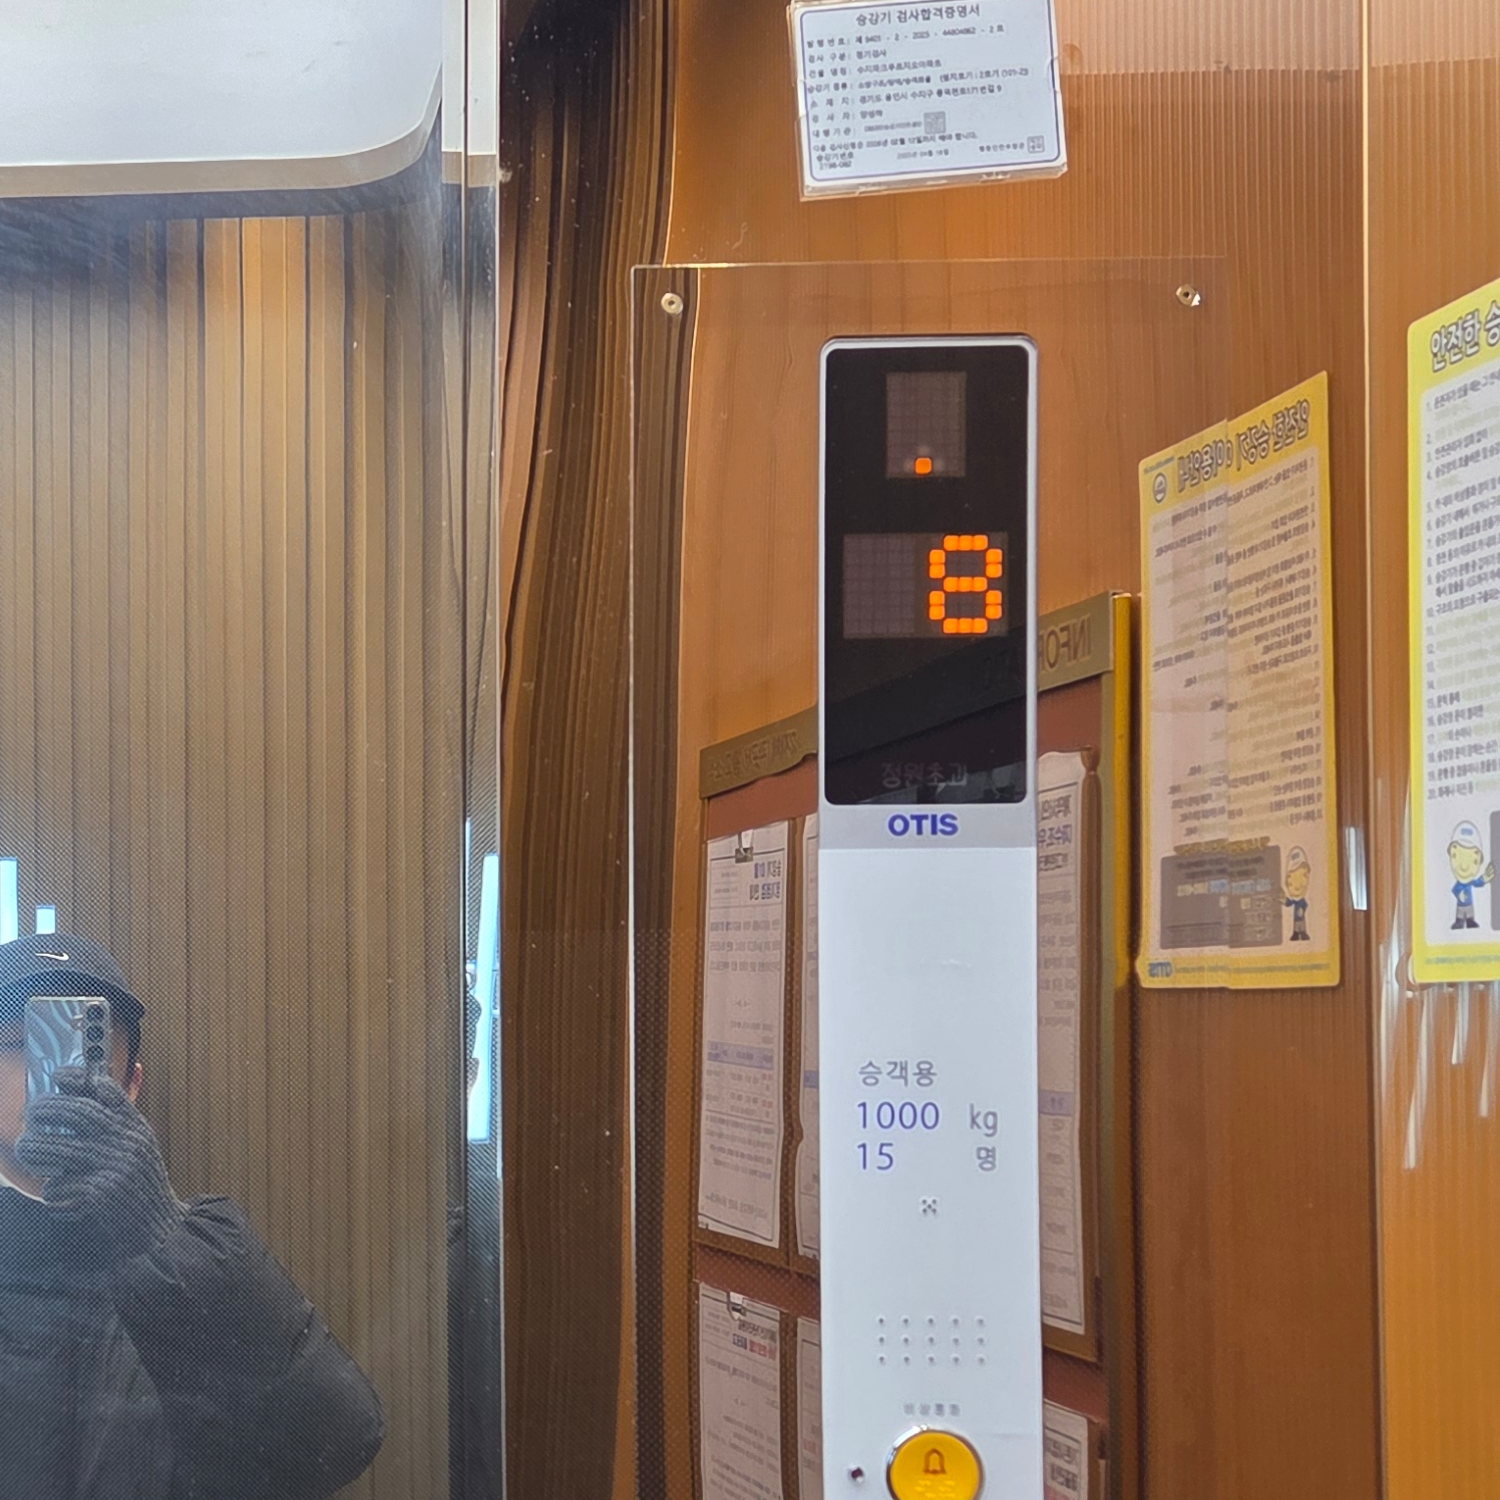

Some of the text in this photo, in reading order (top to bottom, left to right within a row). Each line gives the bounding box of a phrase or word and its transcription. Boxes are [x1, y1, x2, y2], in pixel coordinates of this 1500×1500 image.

[856, 4, 980, 26] 승강기 검사합격증명서
[1430, 309, 1481, 374] 안전한
[929, 534, 1003, 634] 8
[881, 762, 968, 789] 정원초과
[888, 813, 959, 836] OTIS
[858, 1060, 938, 1087] 승객용
[857, 1101, 998, 1138] 1000 kg
[857, 1142, 997, 1172] 15 명
